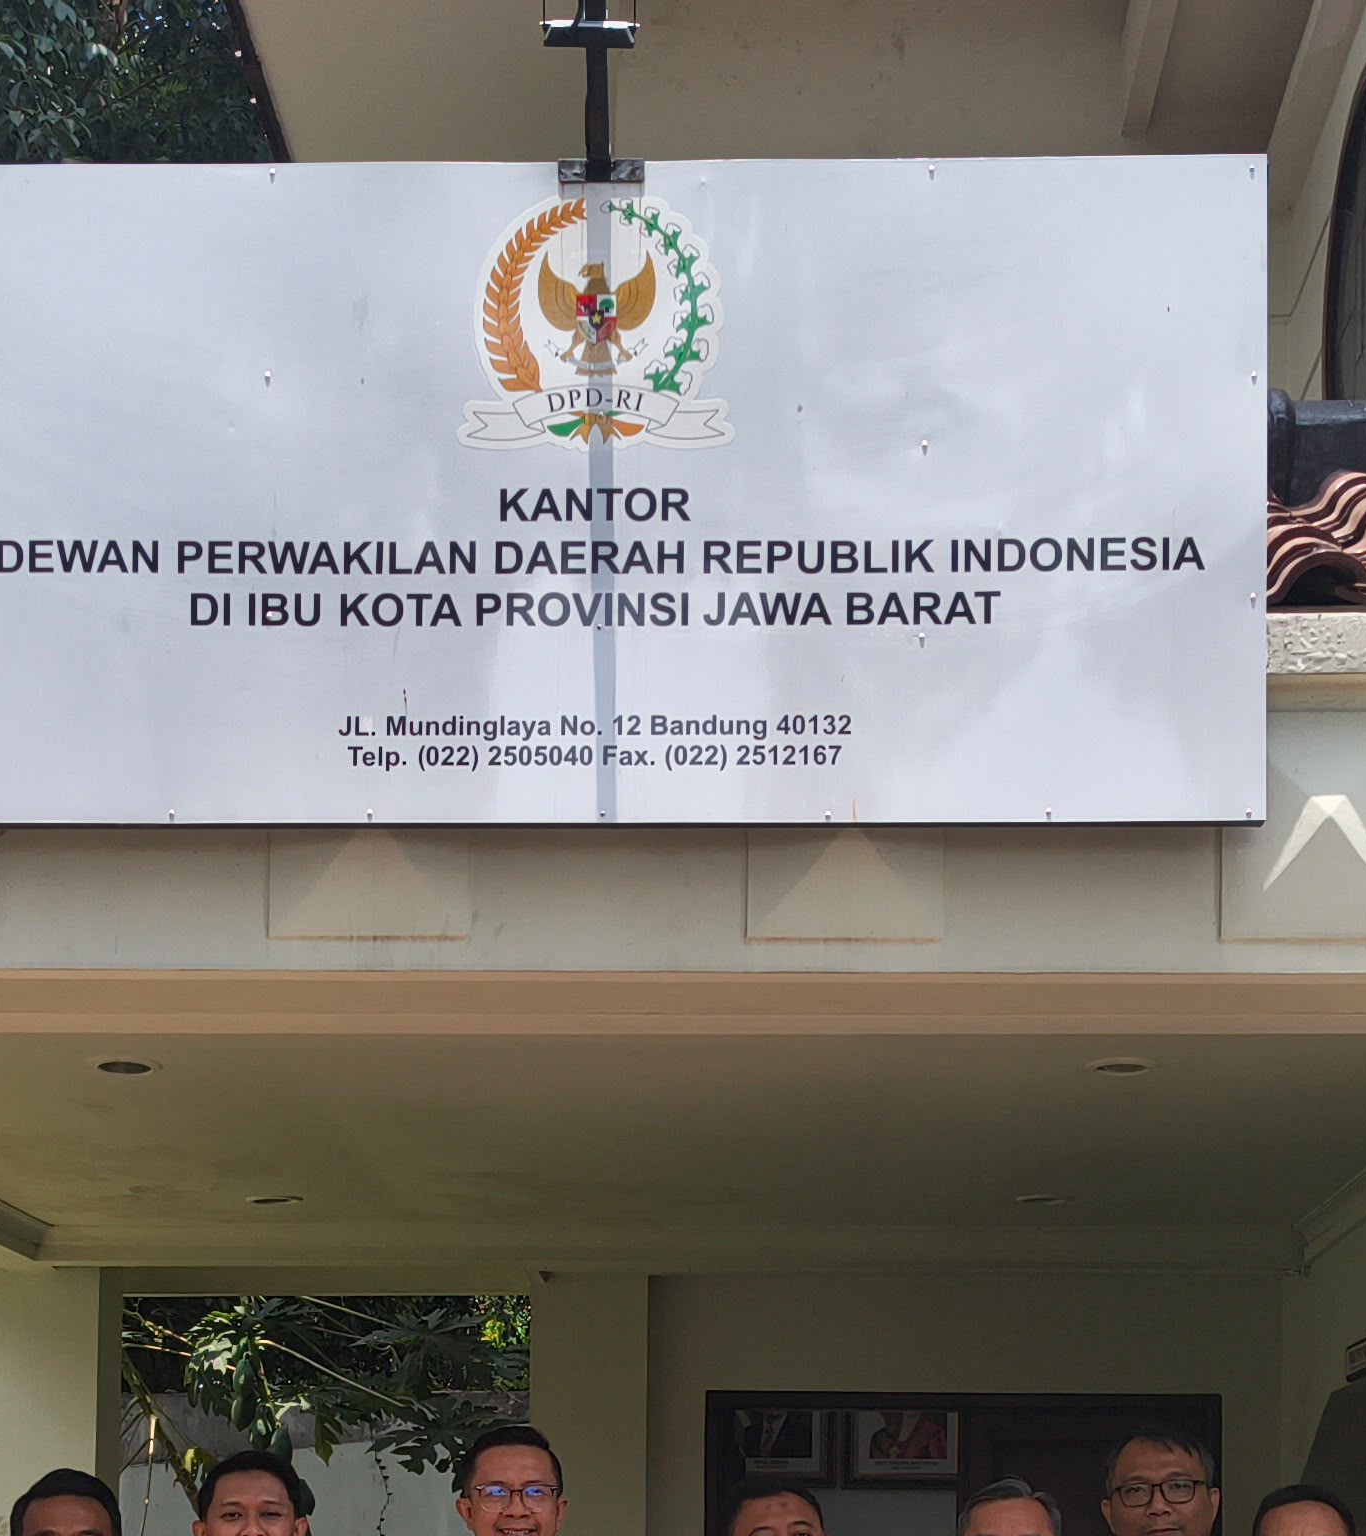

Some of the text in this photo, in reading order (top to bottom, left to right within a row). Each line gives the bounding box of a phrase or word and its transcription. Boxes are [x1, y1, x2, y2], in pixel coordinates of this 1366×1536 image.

[546, 387, 645, 413] DPD-RI
[499, 487, 691, 522] KANTOR
[176, 540, 476, 575] PERWAKILAN
[494, 540, 685, 574] DAERAH
[702, 539, 934, 574] REPUBLIK
[950, 536, 1206, 573] INDONESIA
[189, 590, 1001, 627] DI IBU KOTA PROVINSI JAWA BARAT
[337, 714, 853, 741] JL. Mundinglaya No. 12 Bandung 40132
[346, 744, 843, 772] Telp. (022) 2505040 Fax. (022) 2512167
